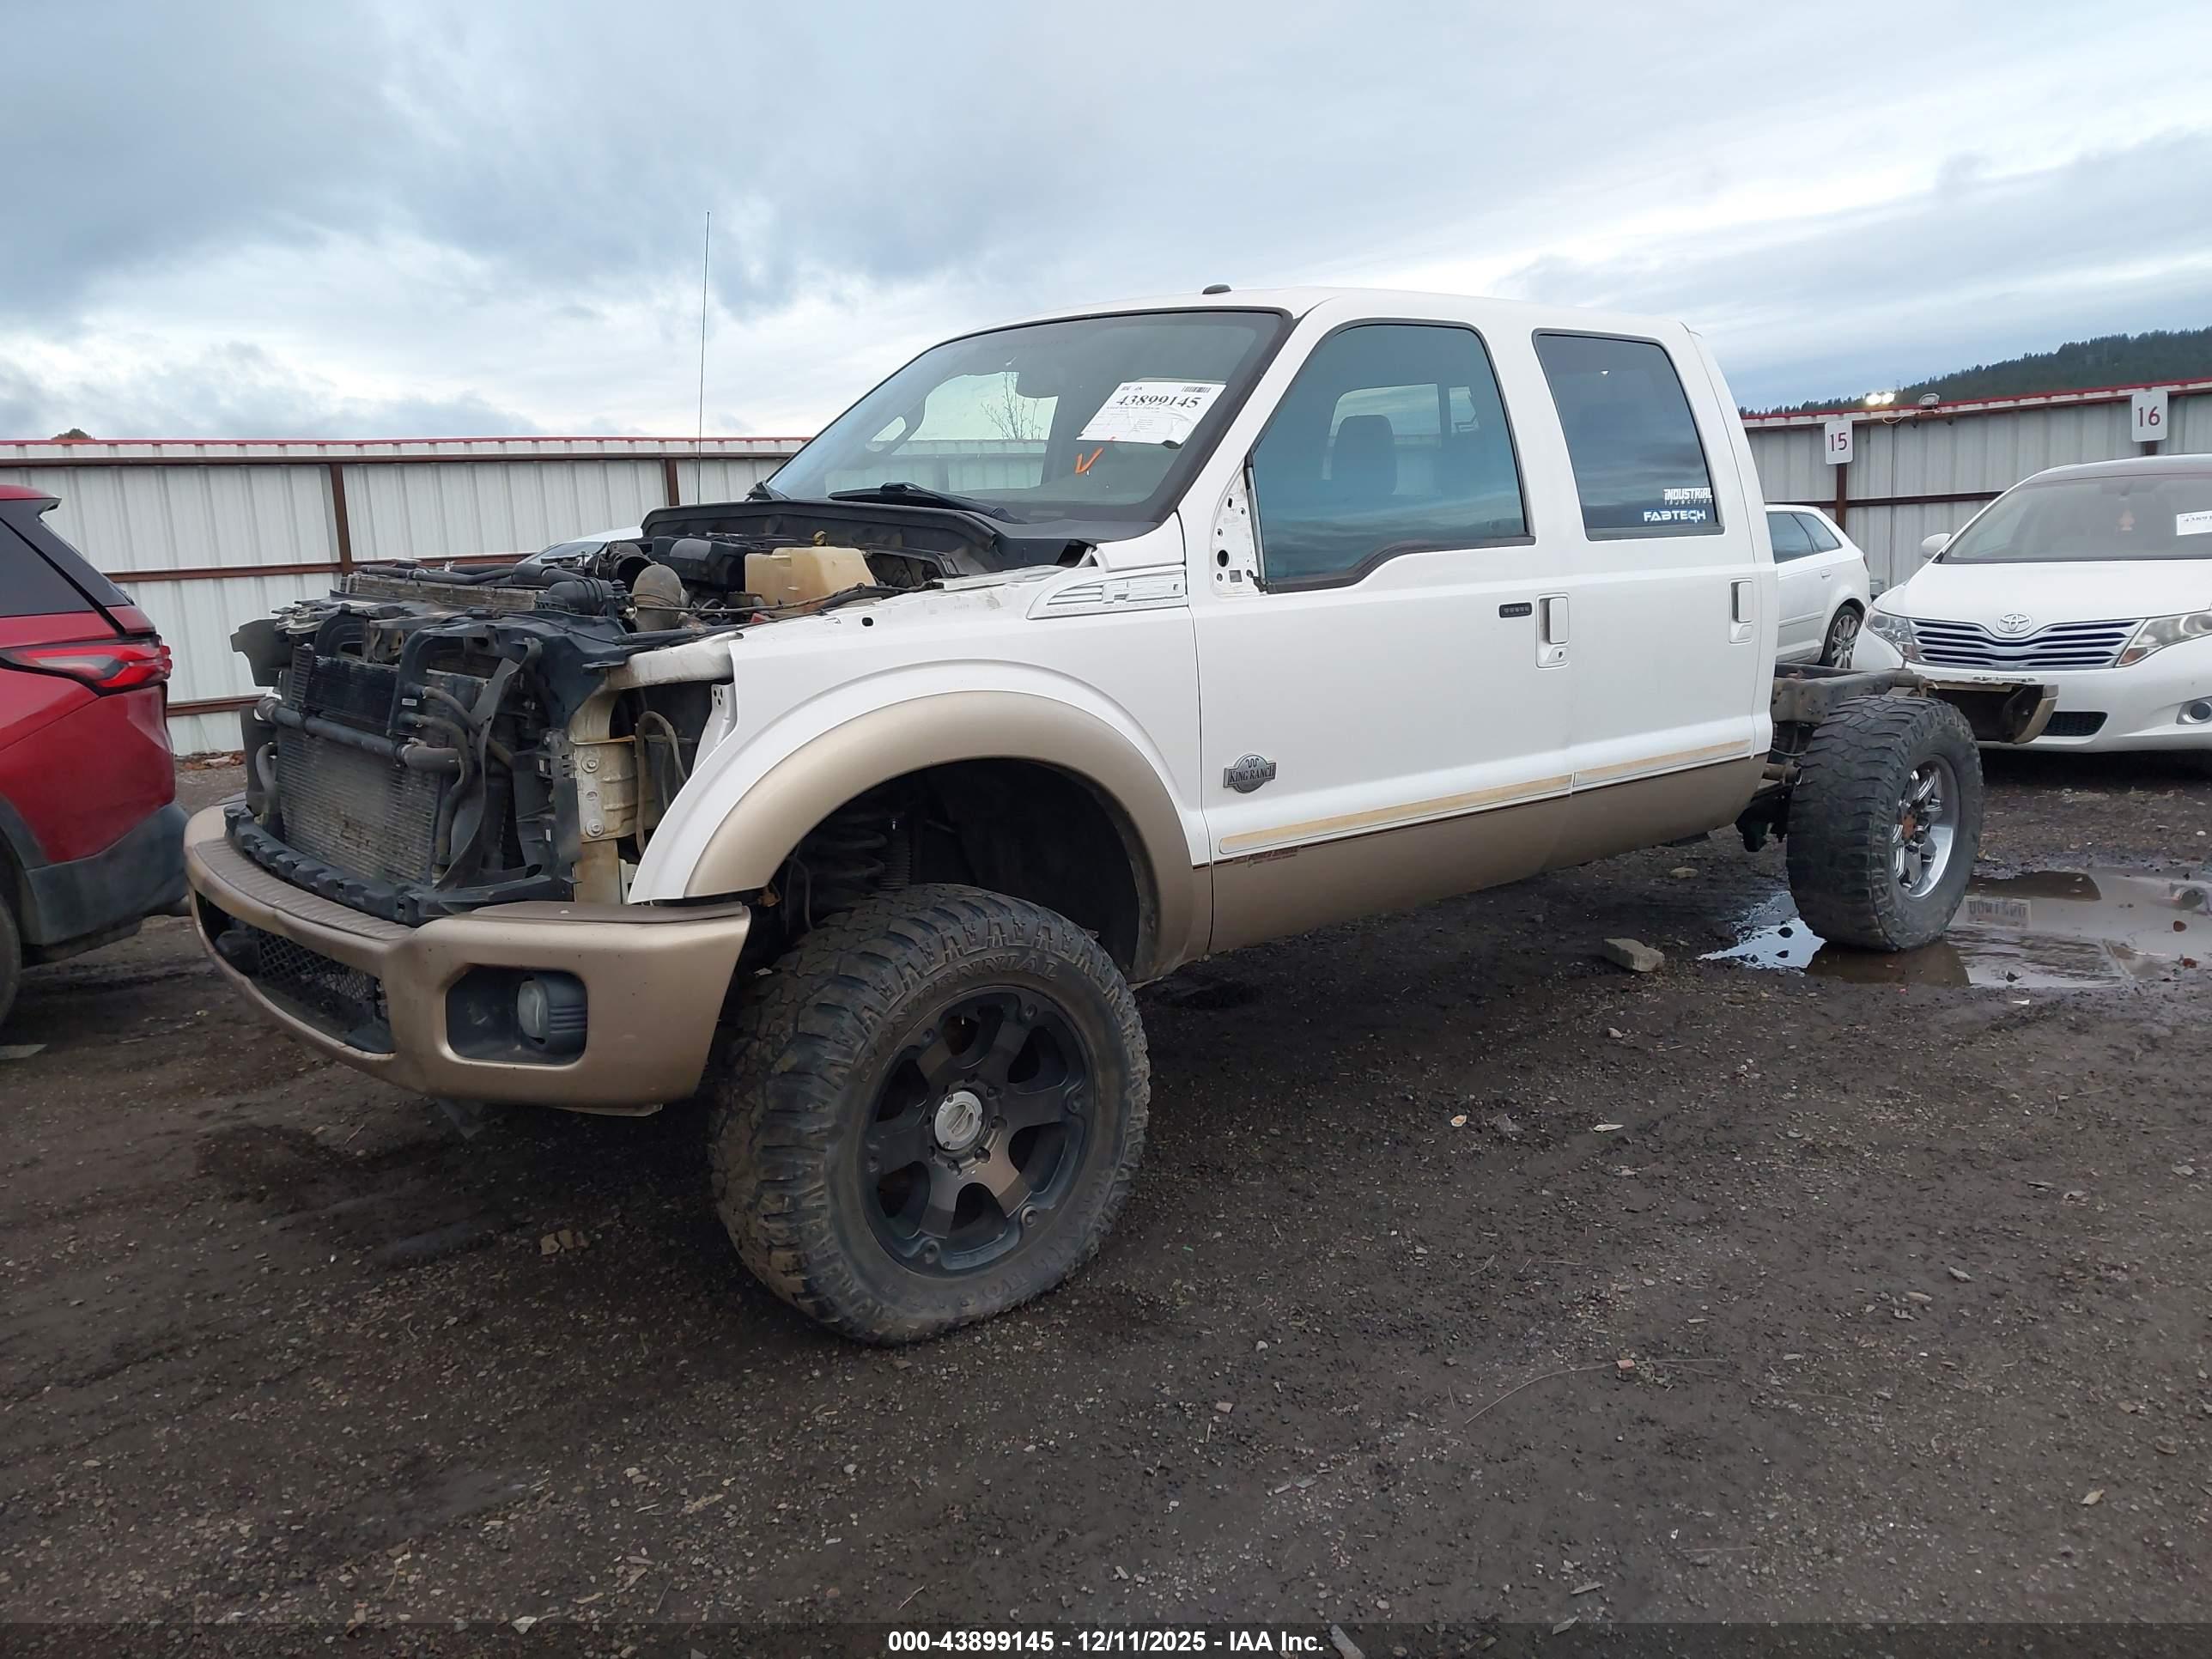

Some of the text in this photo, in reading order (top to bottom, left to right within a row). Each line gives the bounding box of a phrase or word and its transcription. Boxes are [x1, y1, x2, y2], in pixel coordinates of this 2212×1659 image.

[1116, 395, 1203, 409] 43899145
[2138, 405, 2160, 428] 16
[1829, 432, 1848, 453] 15
[1662, 487, 1712, 501] INDUSTRIAL
[1643, 508, 1707, 523] FABTECH
[1229, 764, 1274, 783] KING RANCH
